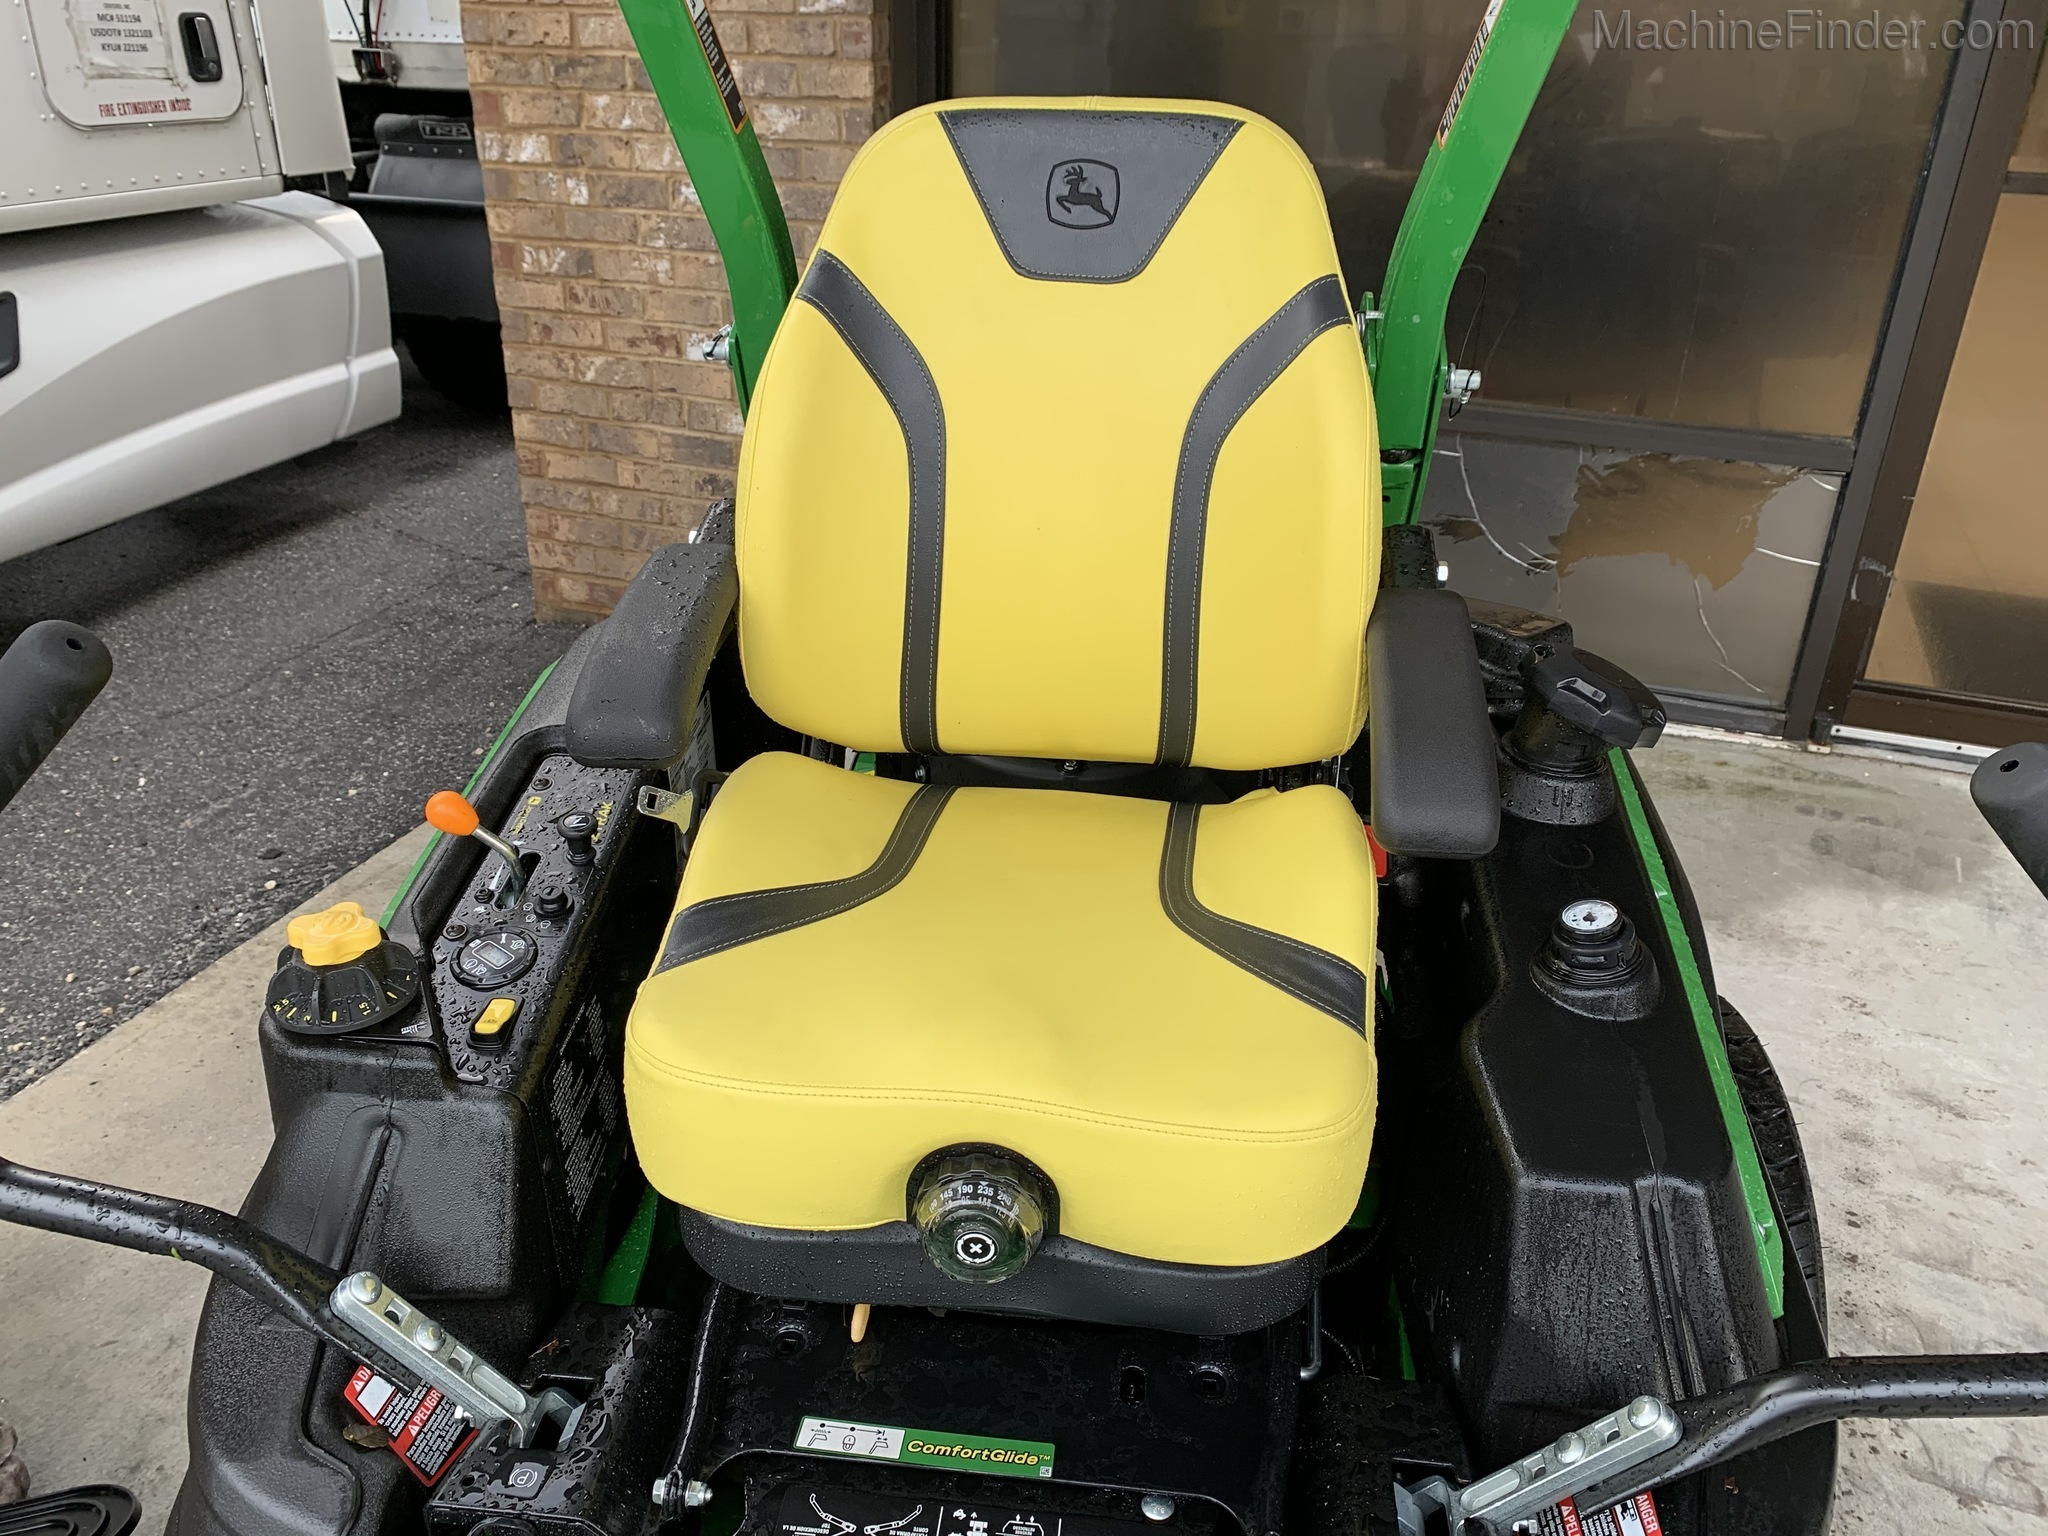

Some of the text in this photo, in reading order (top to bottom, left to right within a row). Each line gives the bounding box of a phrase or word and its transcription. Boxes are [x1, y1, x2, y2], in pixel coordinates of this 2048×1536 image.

[97, 13, 114, 22] MC#
[90, 28, 122, 37] USDOT#
[101, 43, 122, 52] KYU#
[98, 97, 192, 117] FIRE EXTINGUISHER INSIDE
[940, 1188, 953, 1200] 145
[958, 1184, 973, 1194] 190
[977, 1185, 994, 1196] 235
[403, 1410, 412, 1421] and
[411, 1389, 443, 1426] PELIGR
[406, 1445, 417, 1458] Para
[413, 1431, 426, 1447] evitar
[1636, 1494, 1658, 1533] ANGER
